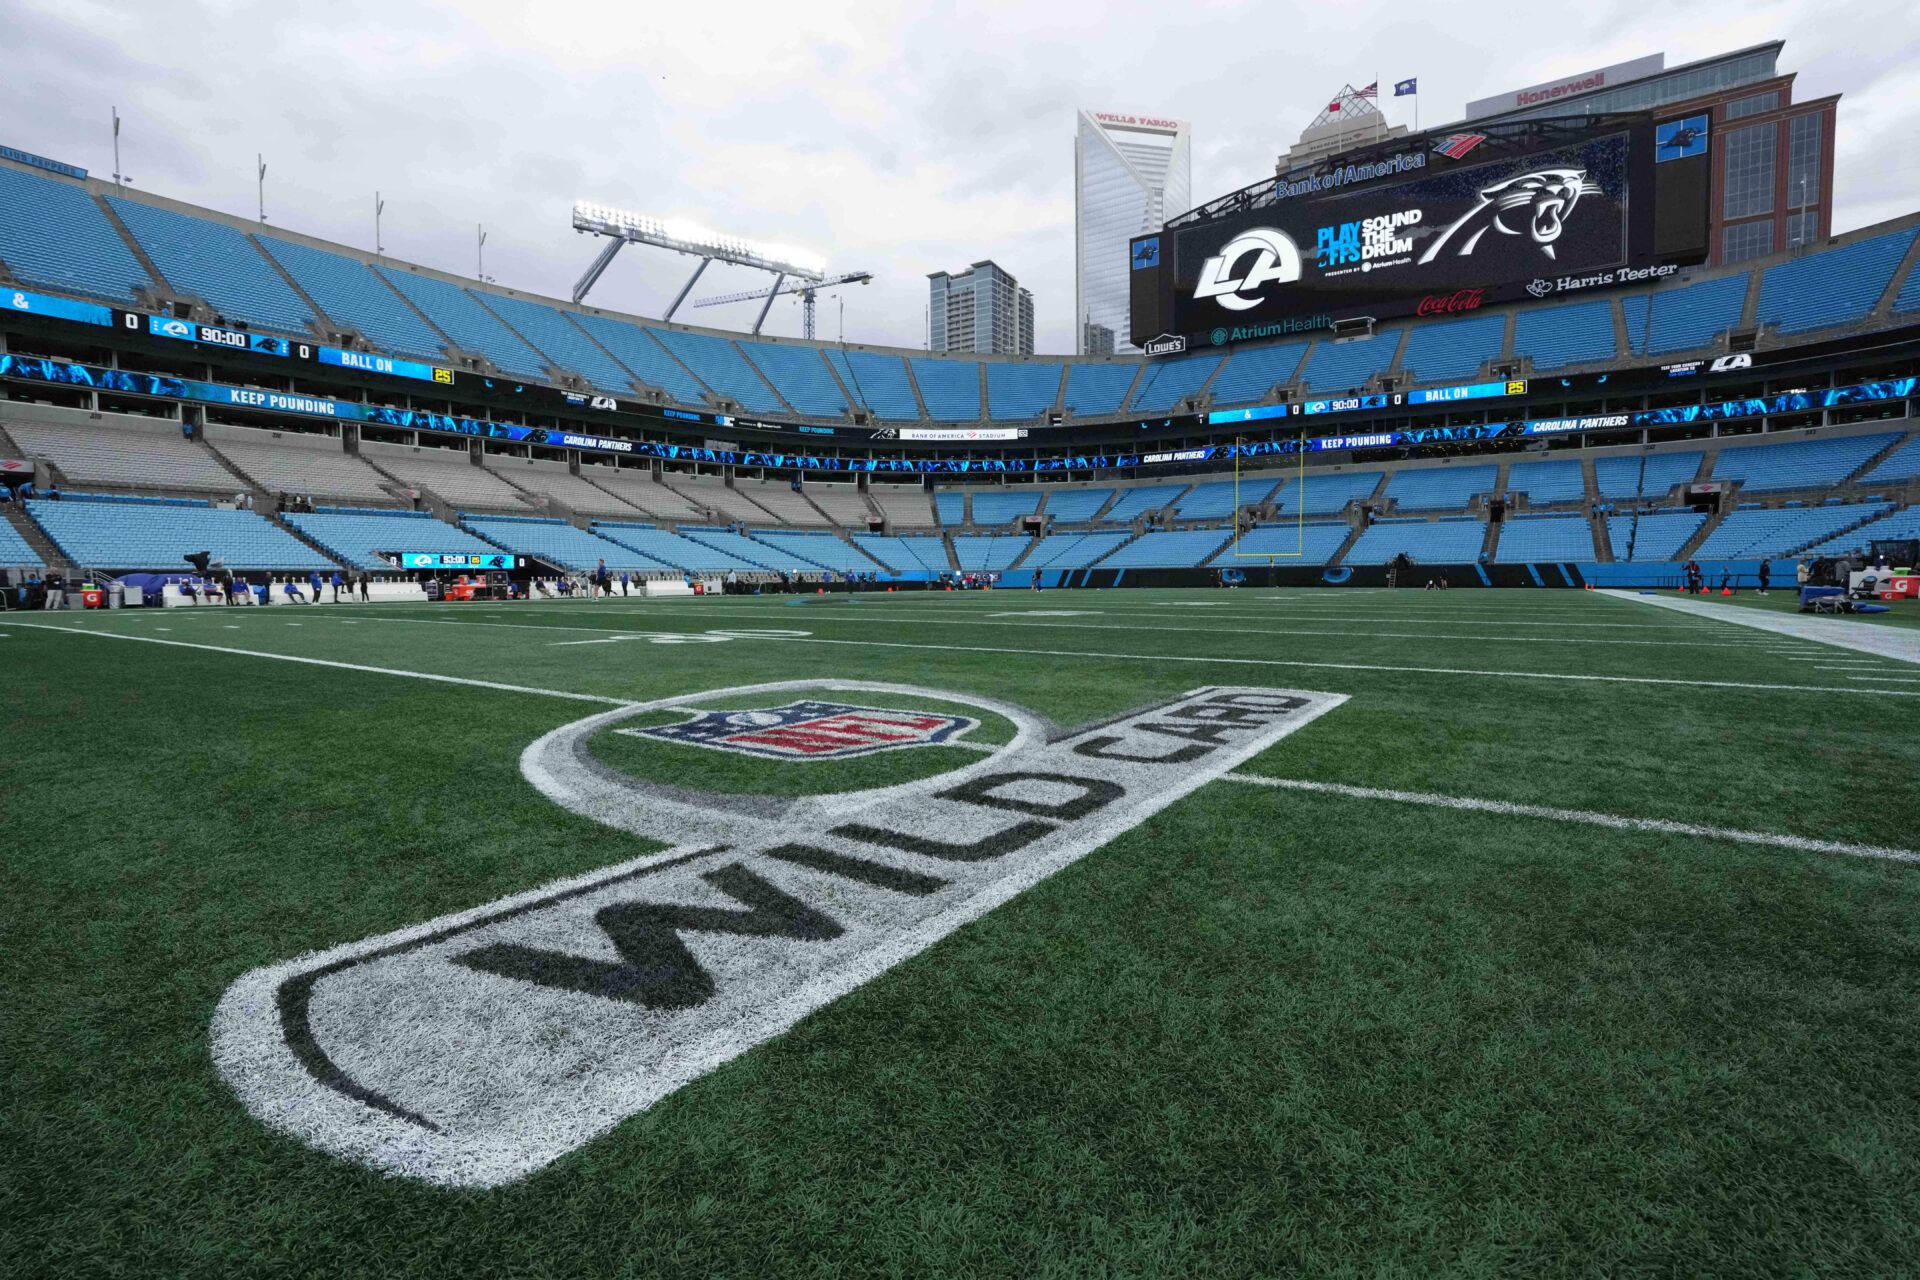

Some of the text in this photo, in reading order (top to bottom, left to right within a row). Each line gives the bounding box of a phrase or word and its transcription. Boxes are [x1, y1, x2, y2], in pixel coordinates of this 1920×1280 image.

[1516, 71, 1605, 107] Honeywell
[1096, 112, 1178, 129] WELLS FARGO
[32, 157, 77, 176] PEPPERS
[1275, 153, 1426, 199] Bank of America
[1361, 208, 1422, 233] SOUND
[1317, 220, 1361, 248] PLAY
[1361, 227, 1395, 246] THE
[1361, 238, 1413, 260] DRUM
[1325, 267, 1353, 277] PRESENTED
[1556, 264, 1678, 291] Harris Teeter
[13, 292, 29, 309] &
[125, 314, 310, 359] 0 90:00 0
[1230, 315, 1332, 341] Atrium Health
[1148, 339, 1182, 354] LOWE'S
[341, 351, 451, 383] BALL ON 25
[230, 389, 335, 415] KEEP POUNDING
[1425, 382, 1524, 402] BALL ON 25
[1292, 404, 1300, 415] 0
[1332, 398, 1359, 411] 90:00
[1394, 394, 1402, 405] 0
[1533, 415, 1629, 433] CAROLINA PANTHERS
[563, 434, 633, 452] CAROLINA PANTHERS
[1321, 434, 1391, 449] KEEP POUNDING
[1143, 450, 1206, 463] CAROLINA PANTHERS
[519, 558, 525, 567] 0
[1895, 580, 1908, 591] G
[86, 593, 98, 602] G
[722, 713, 960, 756] NFL
[449, 693, 1312, 1014] WILD CARD
